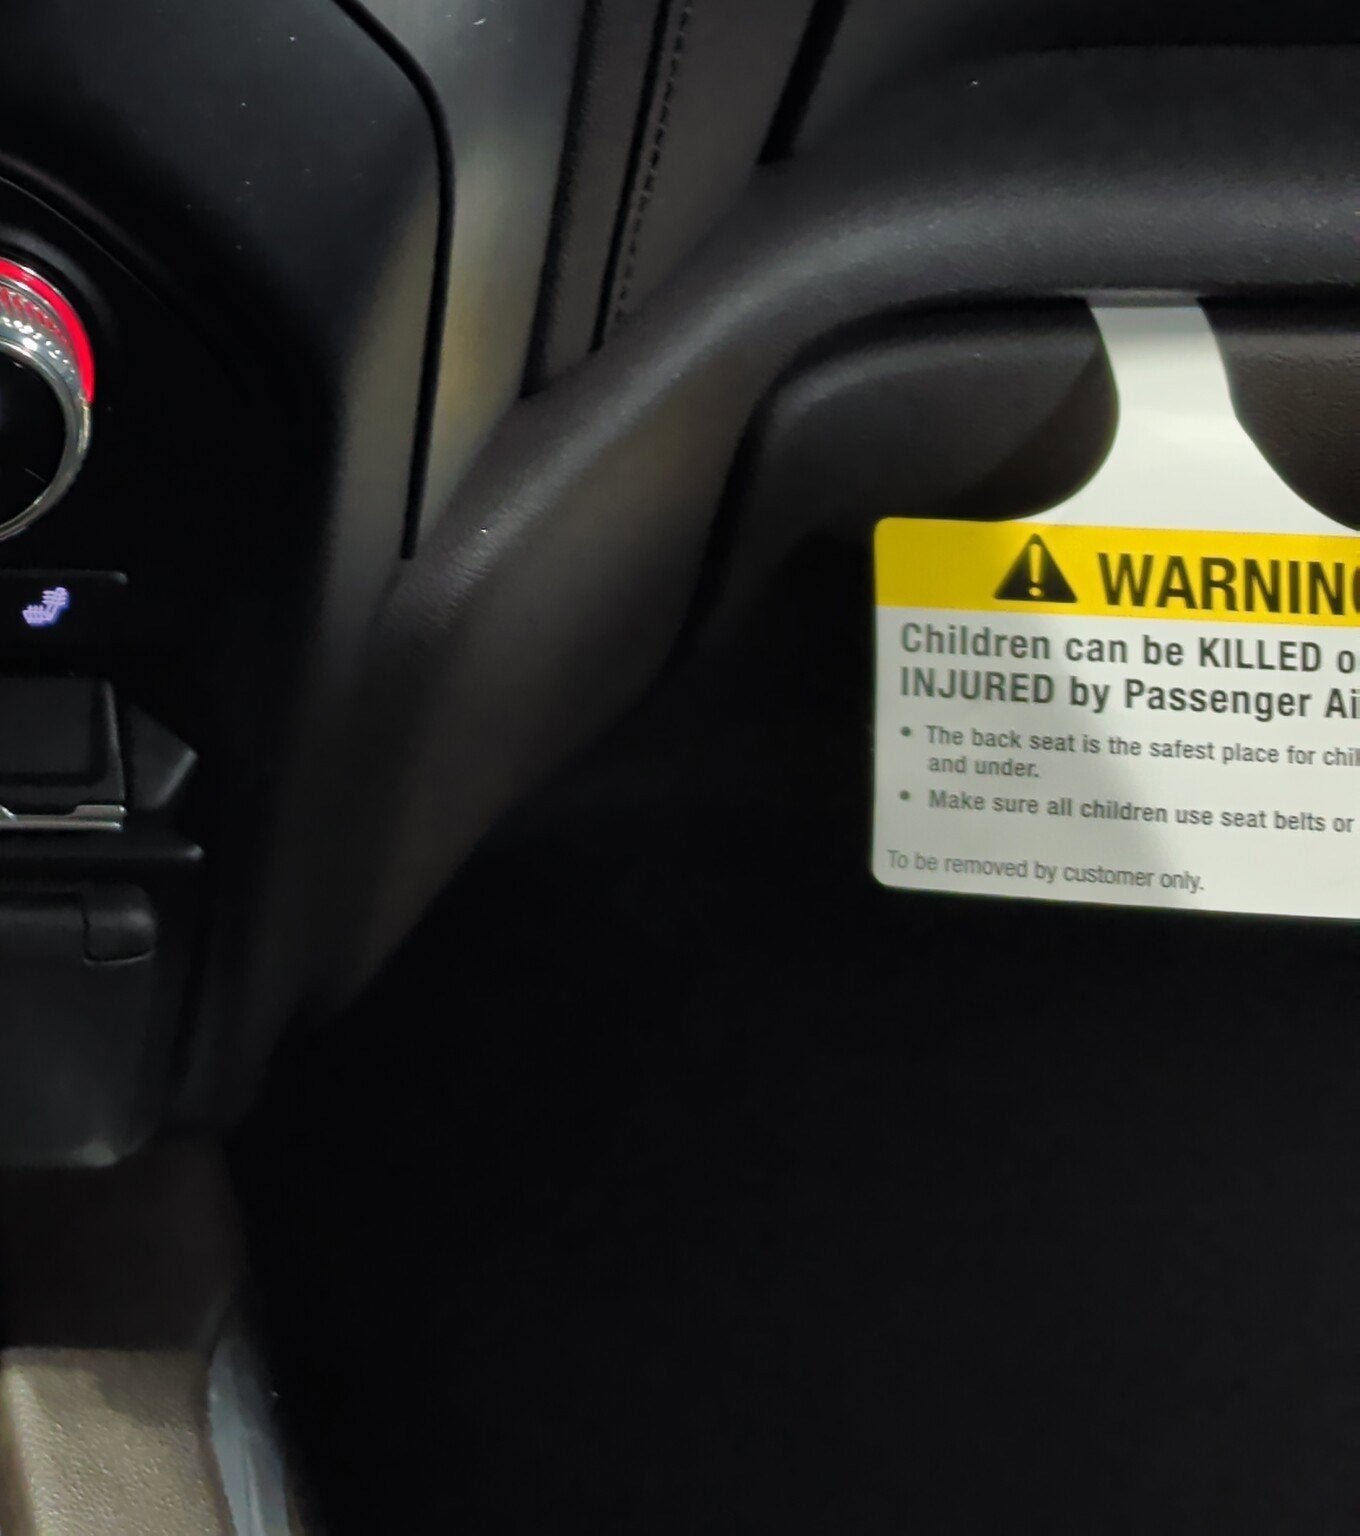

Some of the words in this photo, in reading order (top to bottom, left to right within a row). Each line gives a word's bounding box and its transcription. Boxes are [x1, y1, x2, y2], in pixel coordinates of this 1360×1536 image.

[1098, 552, 1360, 616] WARNIN
[901, 622, 1051, 661] Children
[1065, 636, 1128, 664] can
[1143, 635, 1184, 666] be
[1198, 636, 1321, 673] KILLED
[900, 666, 1054, 704] INJURED
[1069, 676, 1110, 713] by
[1124, 679, 1311, 722] Passenger
[927, 725, 963, 746] The
[972, 727, 1022, 749] back
[1030, 734, 1075, 753] seat
[1082, 734, 1100, 754] is
[1108, 735, 1141, 756] the
[1149, 738, 1215, 760] safest
[1223, 743, 1279, 765] place
[1287, 745, 1314, 766] for
[928, 756, 966, 773] and
[974, 757, 1039, 778] under.
[929, 789, 984, 811] Make
[993, 797, 1039, 814] sure
[1047, 797, 1072, 817] all
[1080, 799, 1167, 823] children
[1174, 808, 1212, 826] use
[1221, 809, 1266, 829] seat
[1275, 810, 1325, 832] belts
[1332, 817, 1354, 833] or
[887, 850, 908, 868] To
[915, 851, 939, 871] be
[944, 853, 1028, 879] removed
[1035, 859, 1058, 884] by
[1063, 862, 1154, 887] customer
[1160, 871, 1204, 891] only.
